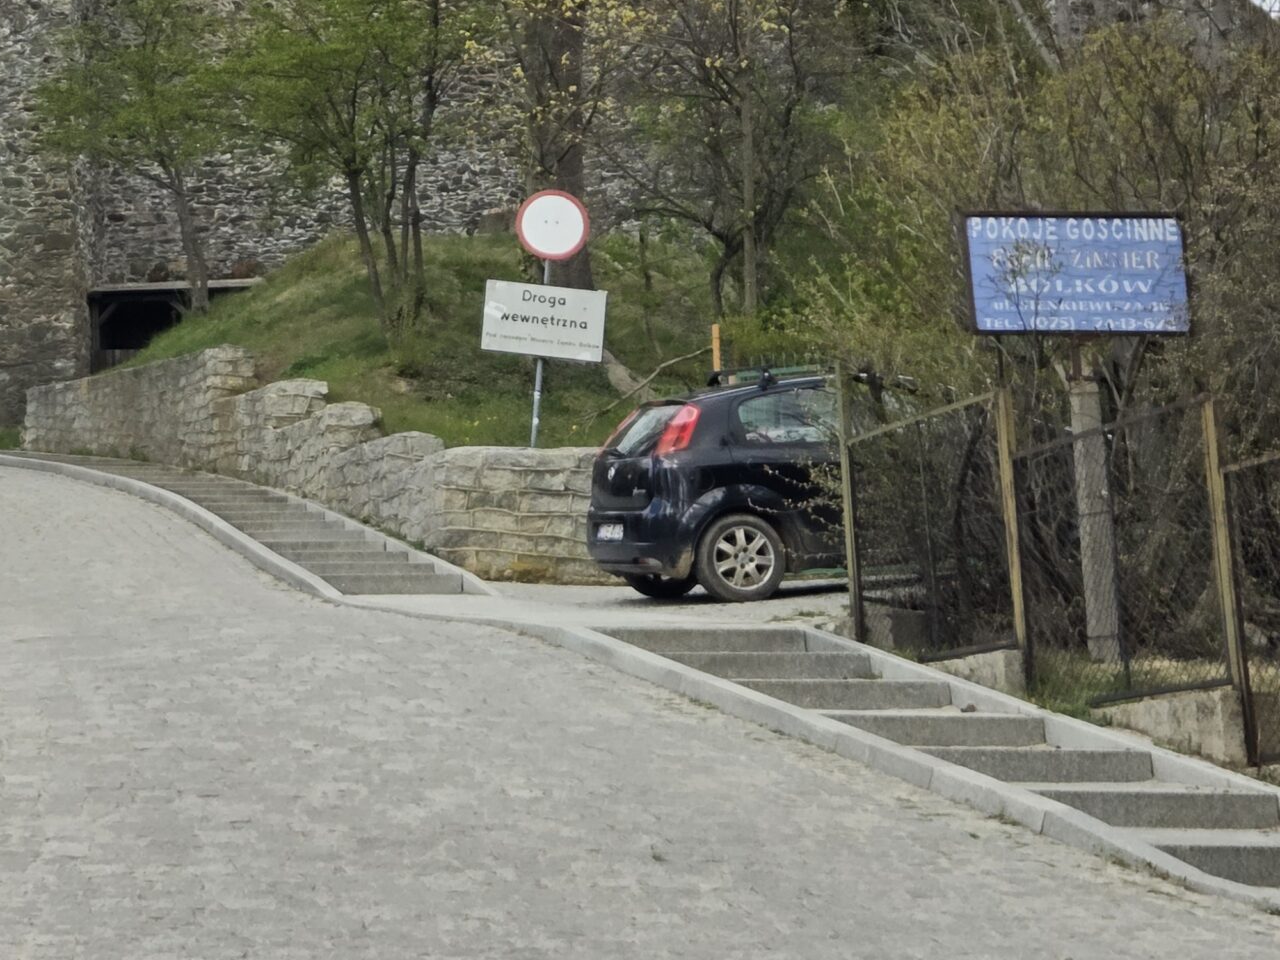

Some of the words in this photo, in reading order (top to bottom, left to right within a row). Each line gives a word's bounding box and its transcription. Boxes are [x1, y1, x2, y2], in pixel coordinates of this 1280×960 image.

[971, 217, 1058, 240] POKOJE
[1008, 274, 1153, 294] BOLKÓW
[522, 289, 567, 308] Droga
